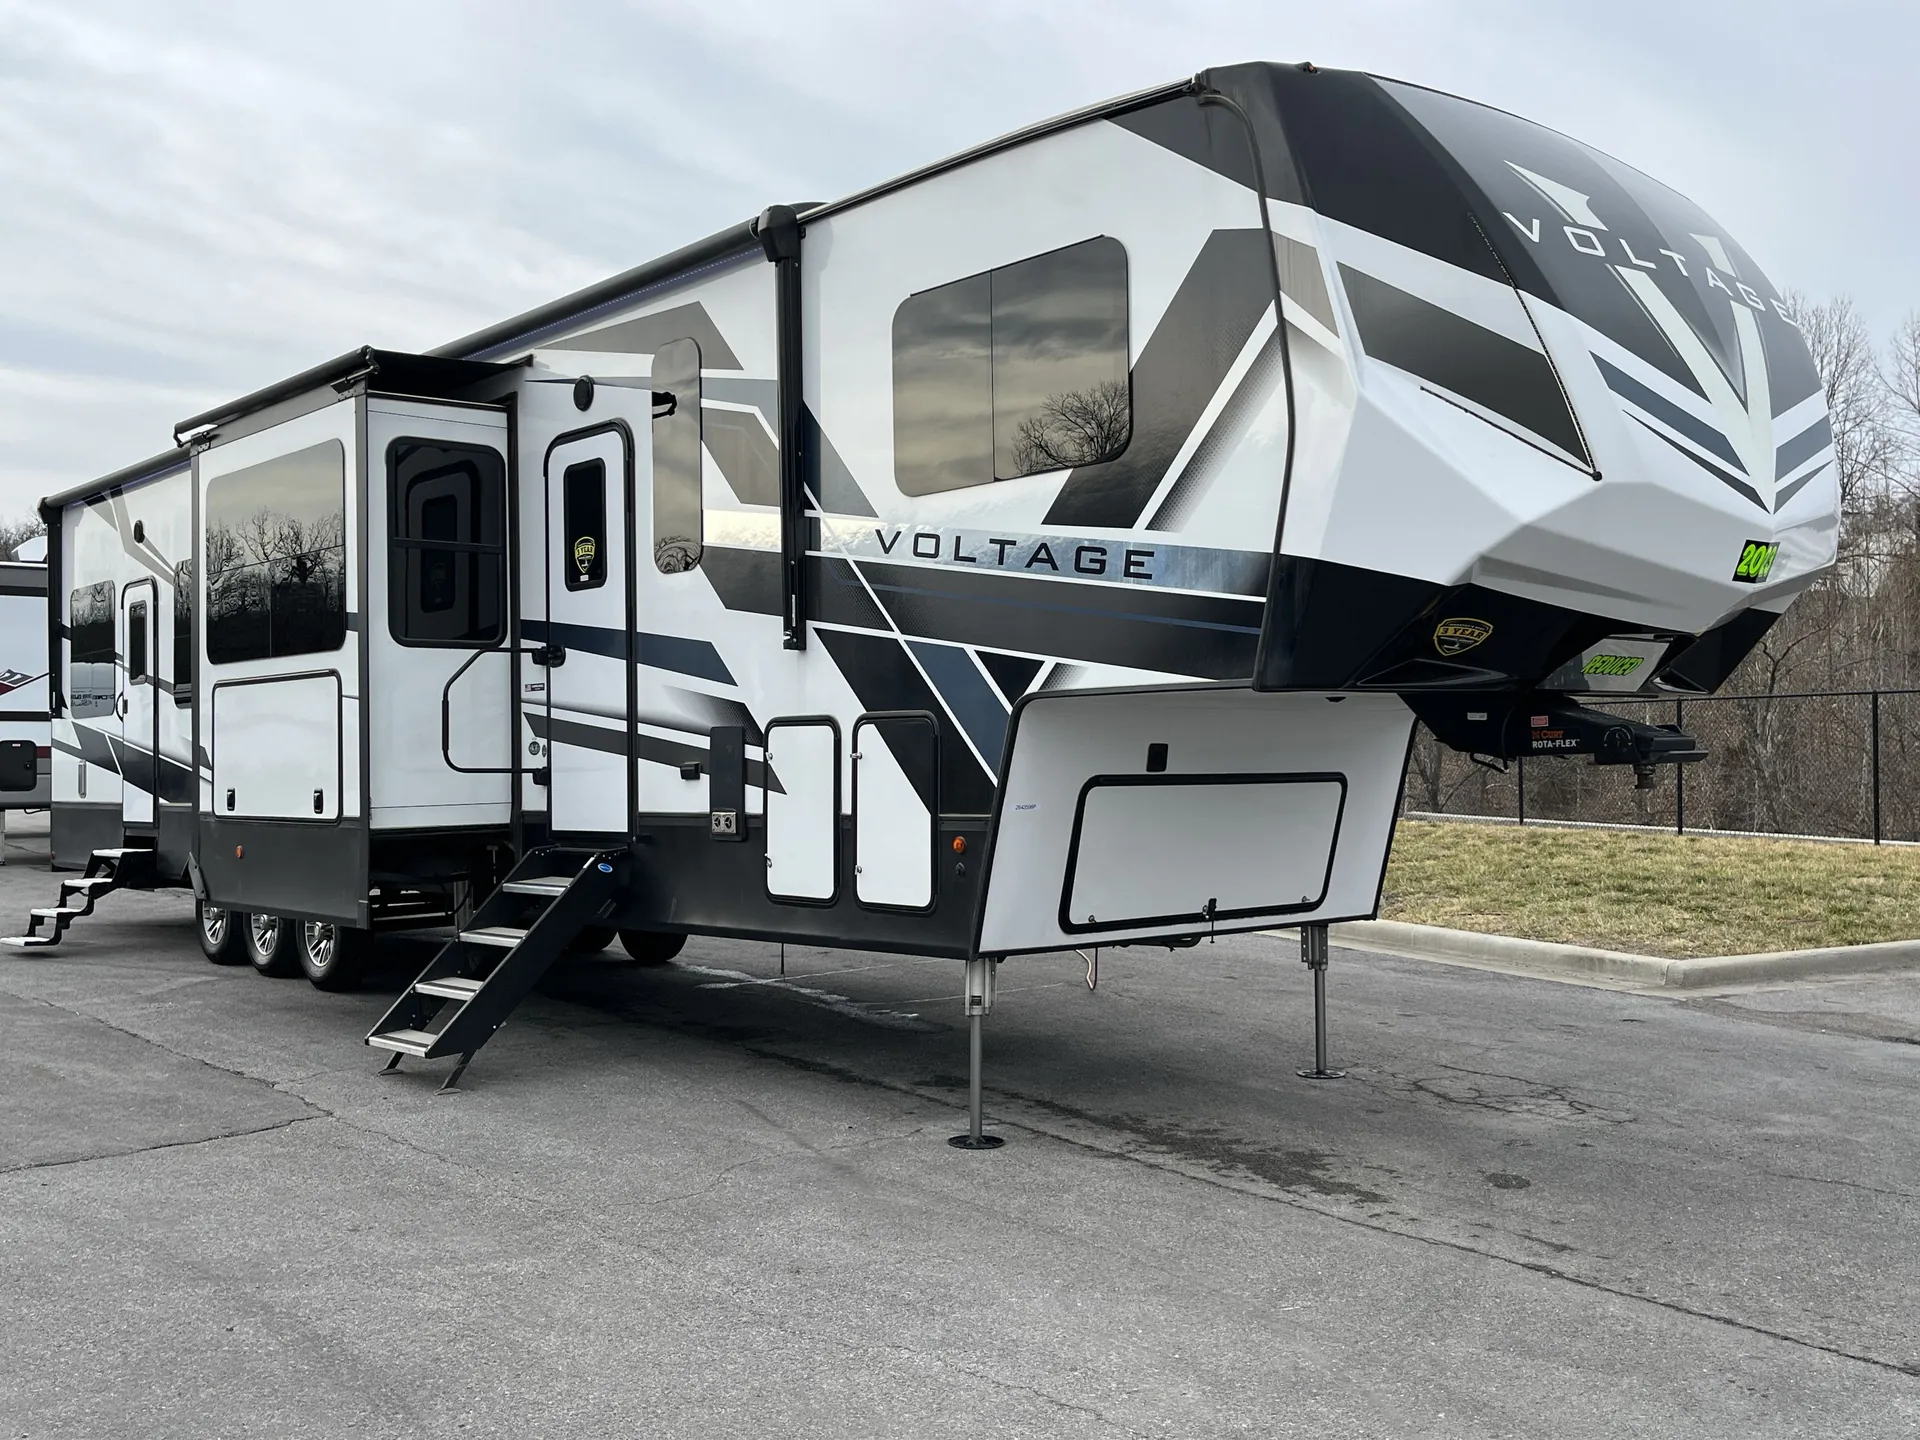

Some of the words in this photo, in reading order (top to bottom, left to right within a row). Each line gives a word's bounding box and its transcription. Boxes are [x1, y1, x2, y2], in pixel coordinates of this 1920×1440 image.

[1502, 211, 1798, 327] VOLTAGE
[875, 529, 1155, 580] VOLTAGE
[1453, 628, 1485, 639] YEAR
[1580, 655, 1645, 677] REDUCED
[1532, 739, 1577, 749] ROTA-FLEX
